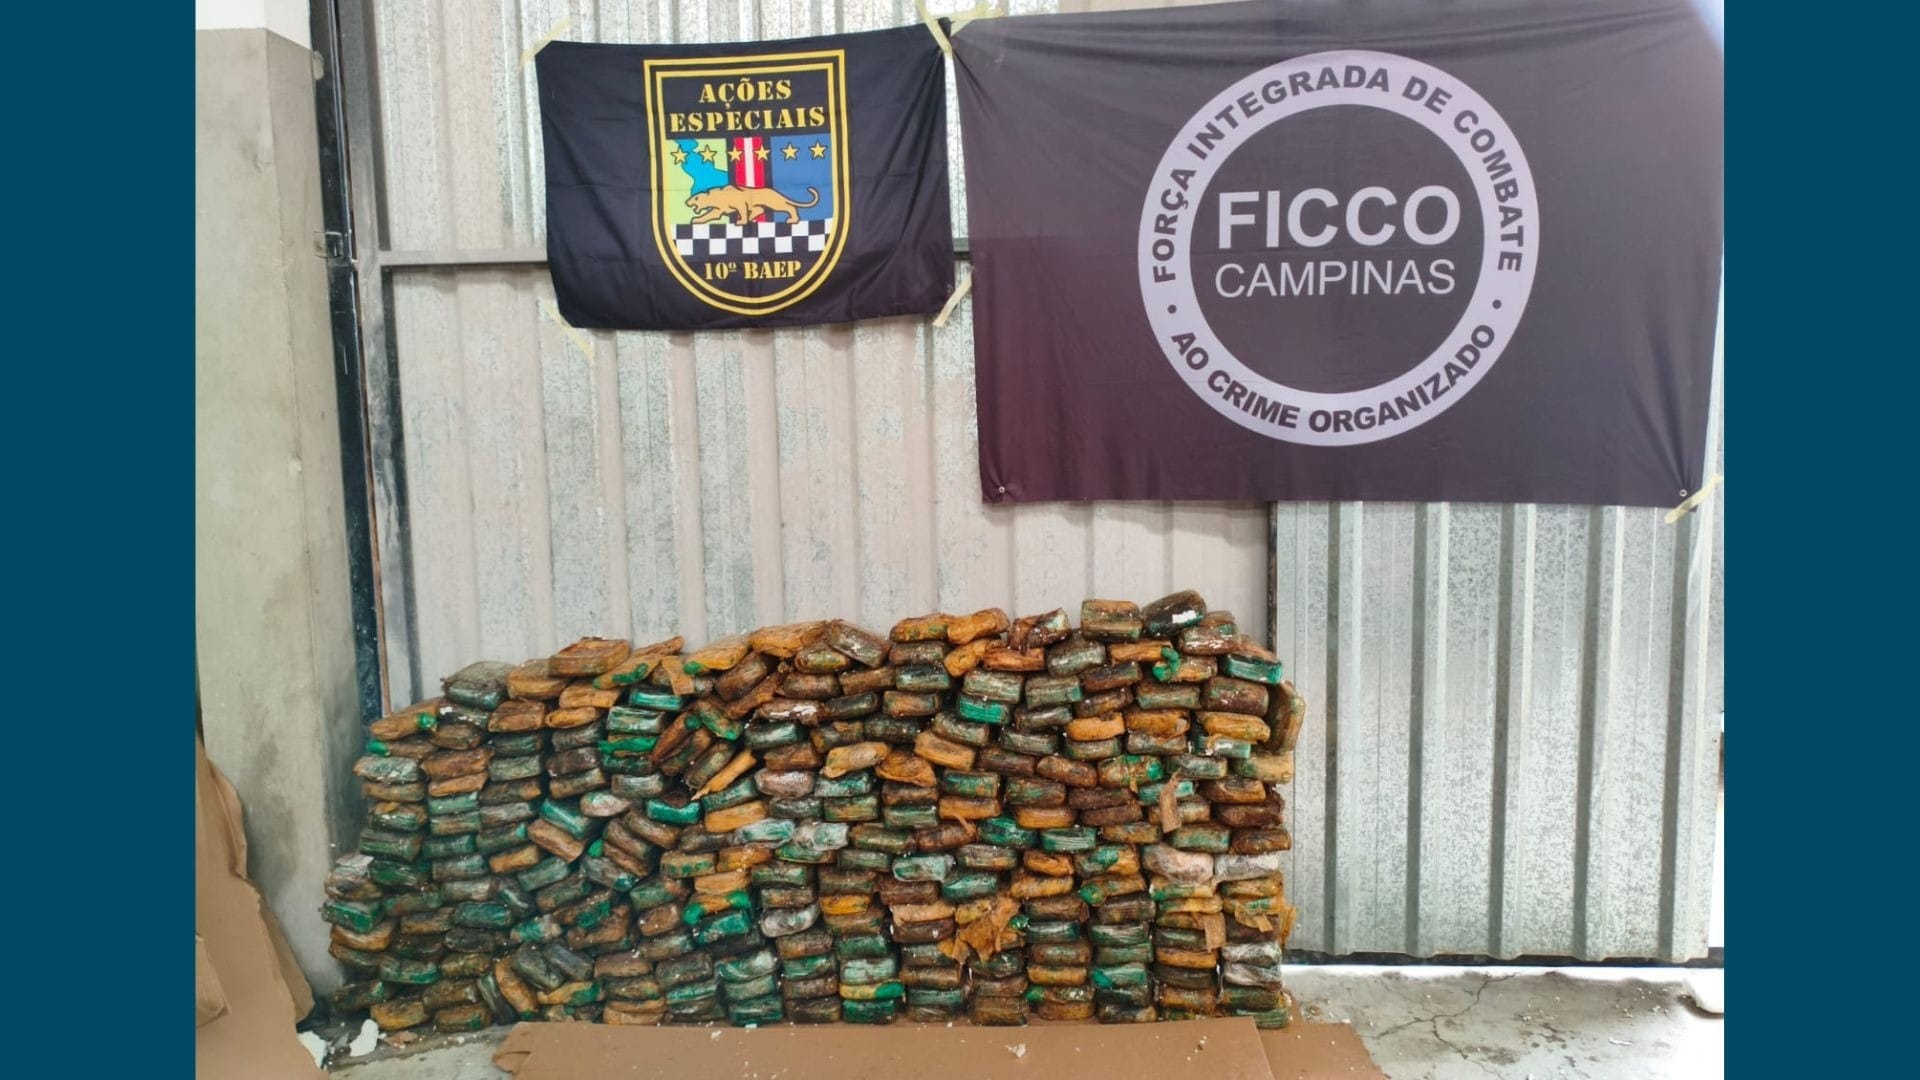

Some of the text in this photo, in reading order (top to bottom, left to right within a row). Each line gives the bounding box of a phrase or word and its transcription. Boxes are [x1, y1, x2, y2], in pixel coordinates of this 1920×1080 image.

[698, 77, 792, 110] AÇÕES
[669, 106, 826, 132] ESPECIAIS
[1152, 65, 1524, 283] FORÇA INTEGRADA DE COMBATE
[1218, 184, 1461, 249] FICCO
[704, 260, 802, 280] 10º BAEP
[1214, 259, 1456, 298] CAMPINAS
[1170, 324, 1495, 433] AO CRIME ORGANIZADO
